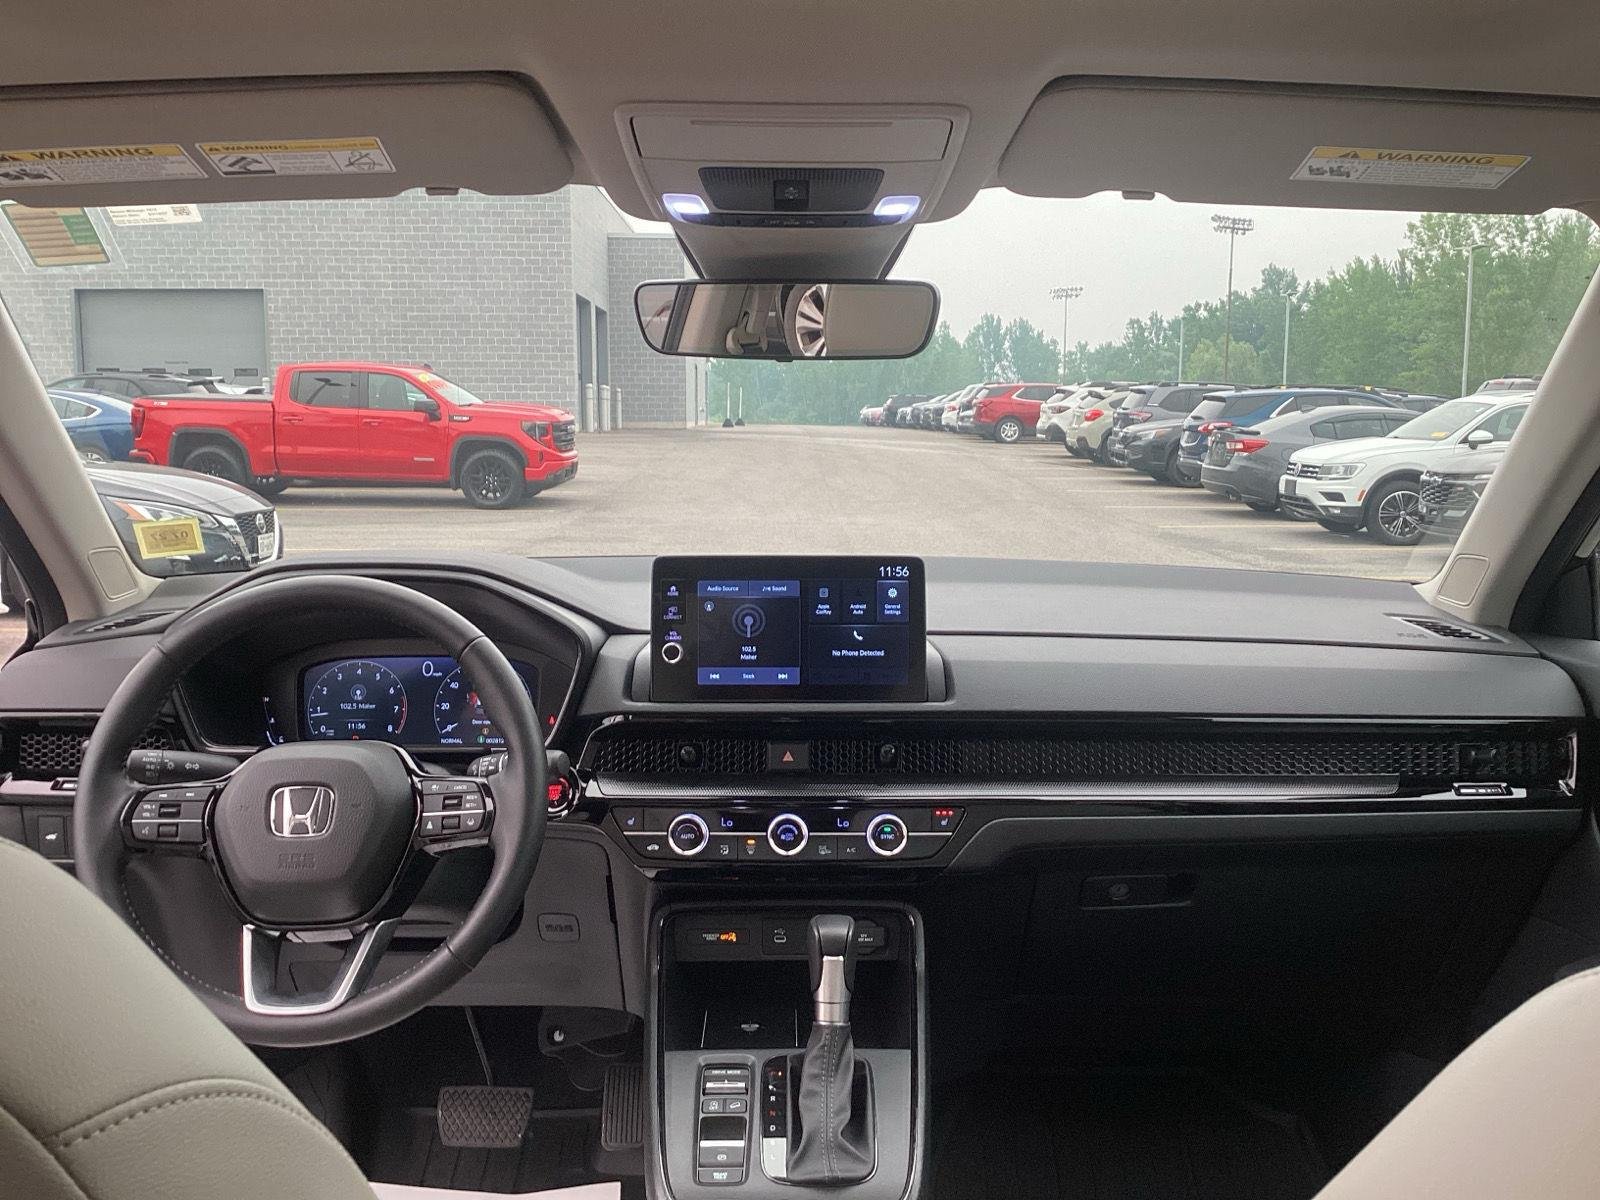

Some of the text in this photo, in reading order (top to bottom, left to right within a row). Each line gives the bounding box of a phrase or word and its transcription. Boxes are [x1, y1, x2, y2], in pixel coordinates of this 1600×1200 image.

[31, 147, 153, 161] WARNING
[1377, 151, 1495, 165] WARNING
[880, 566, 909, 577] 11:56
[422, 661, 434, 676] 0
[721, 817, 733, 827] Lo
[837, 817, 849, 827] Lo
